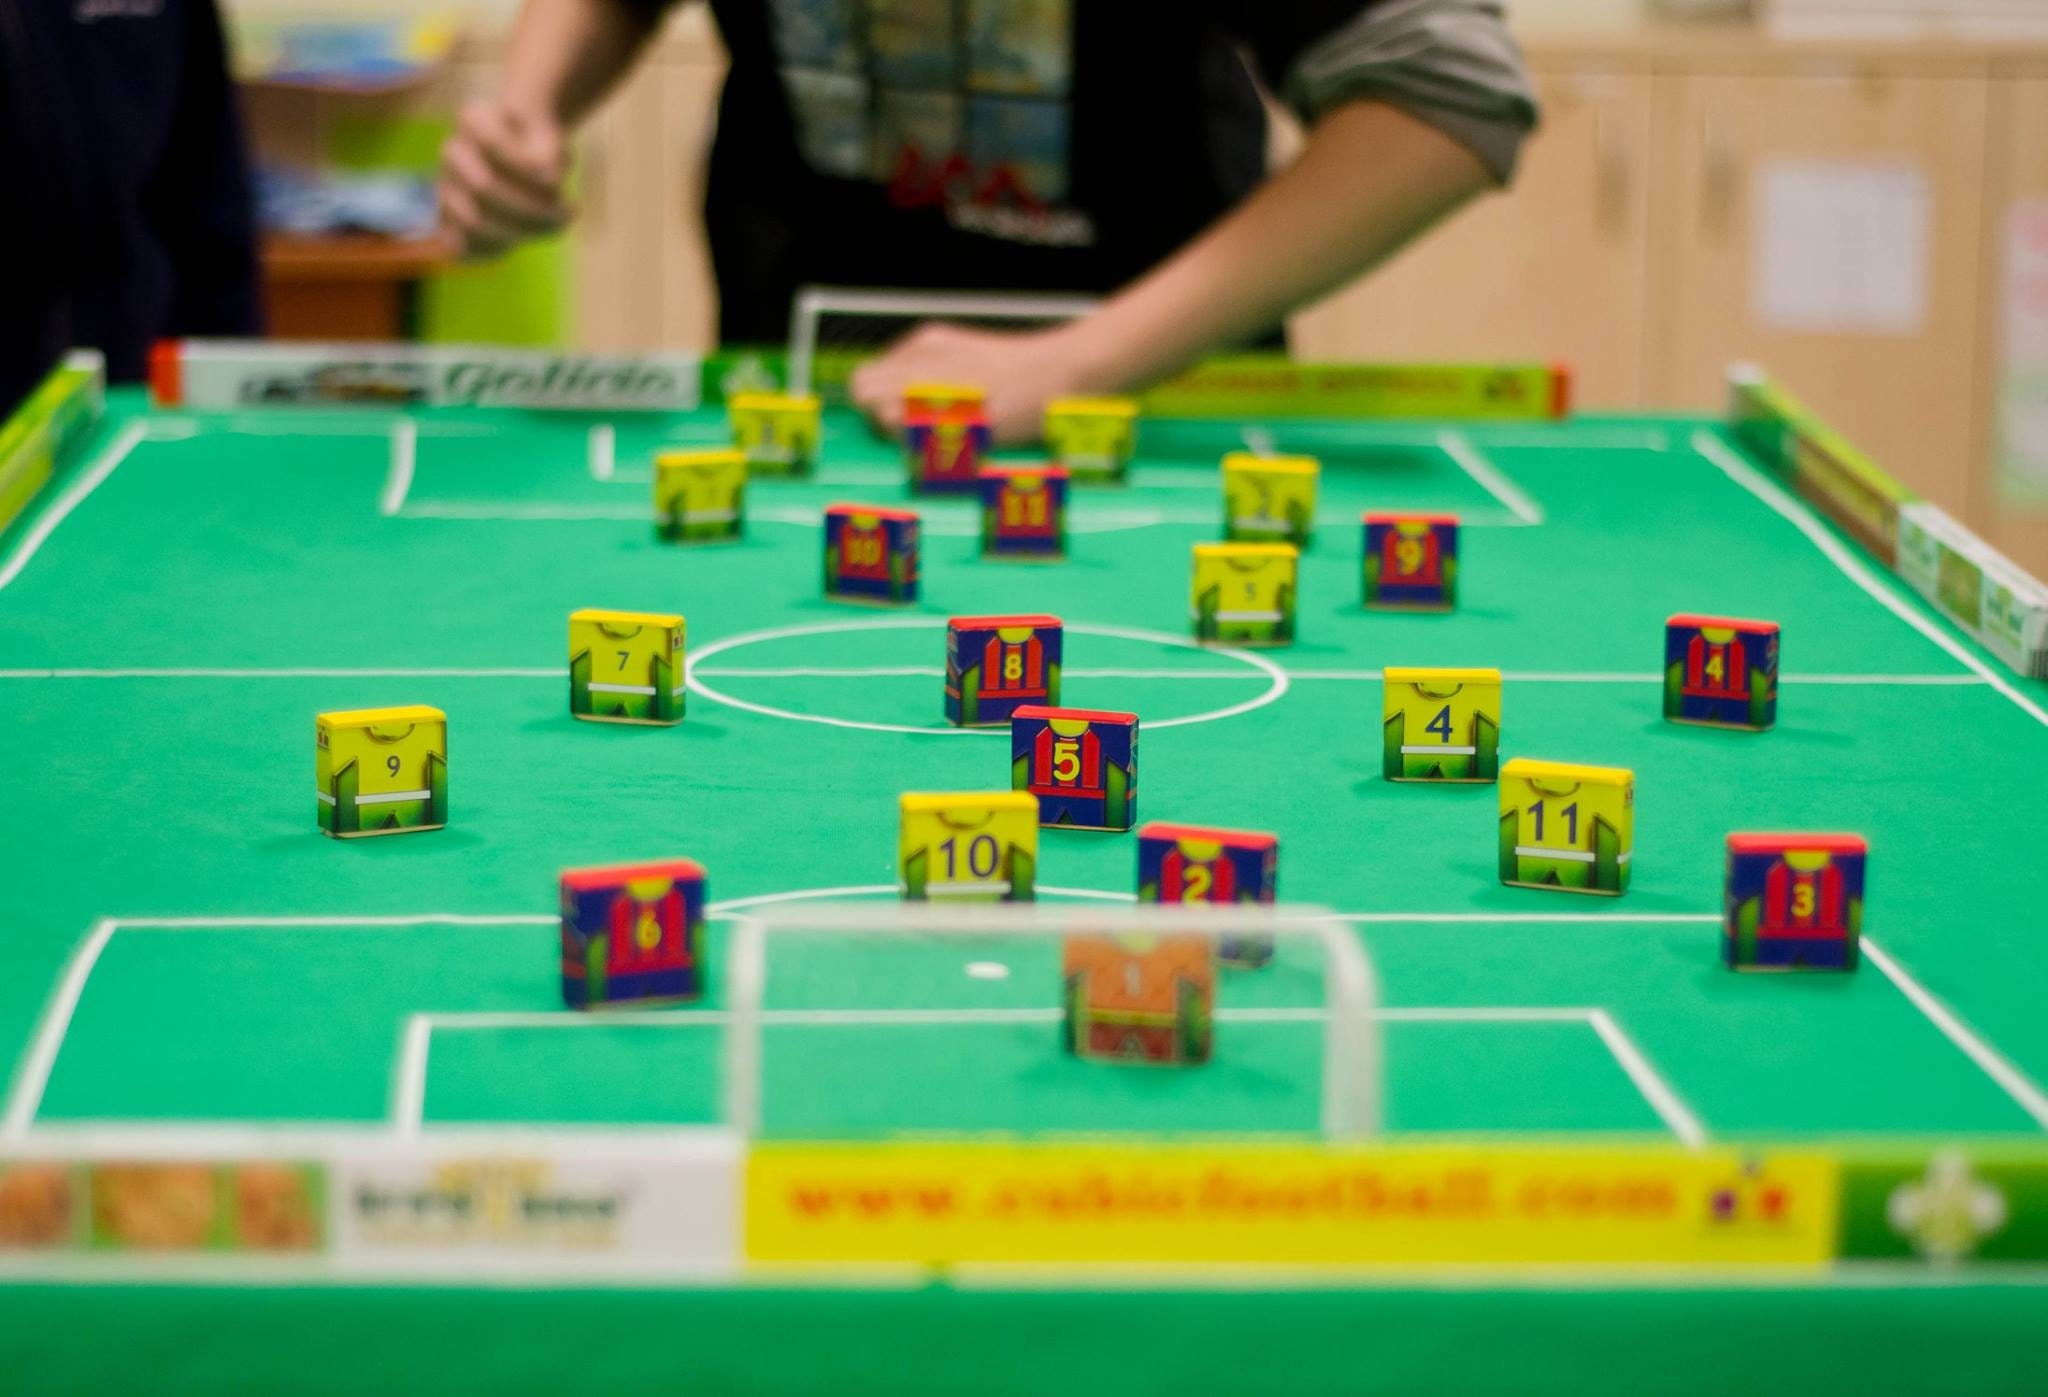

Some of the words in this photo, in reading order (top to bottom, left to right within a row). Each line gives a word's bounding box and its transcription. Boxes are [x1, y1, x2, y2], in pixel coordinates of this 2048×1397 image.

[1397, 539, 1422, 576] 9
[616, 651, 630, 671] 7
[1003, 653, 1023, 681] 8
[1704, 655, 1724, 682] 4
[1424, 704, 1453, 743] 4
[386, 755, 402, 778] 9
[1052, 742, 1080, 781] 5
[1527, 799, 1578, 845] 11
[939, 833, 1001, 879] 10
[1181, 863, 1212, 907] 2
[1790, 882, 1815, 918] 3
[635, 907, 662, 950] 6
